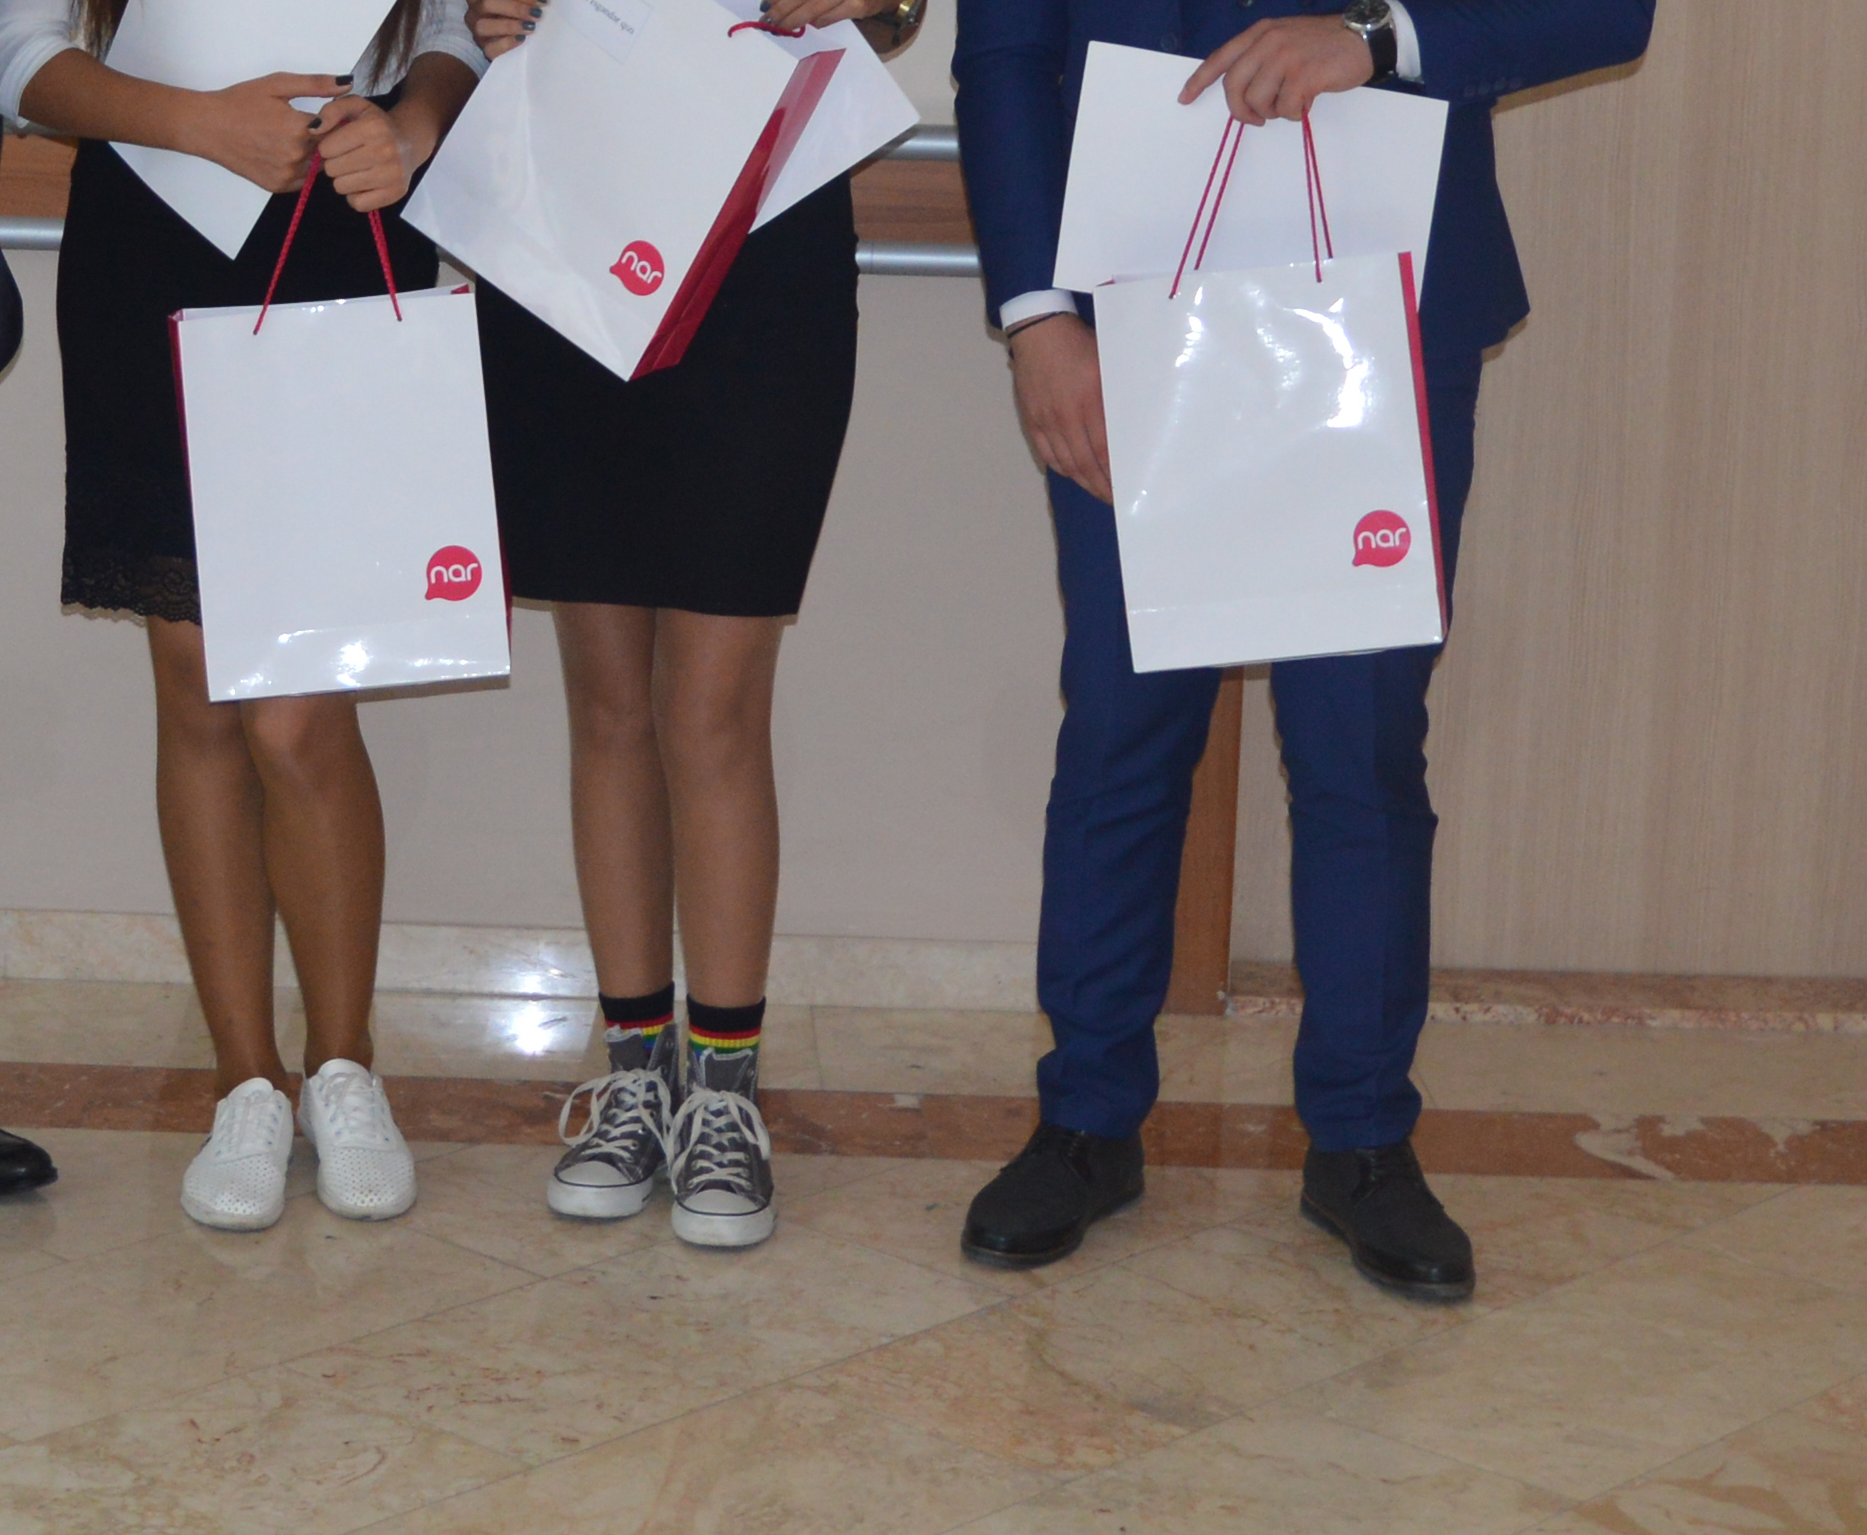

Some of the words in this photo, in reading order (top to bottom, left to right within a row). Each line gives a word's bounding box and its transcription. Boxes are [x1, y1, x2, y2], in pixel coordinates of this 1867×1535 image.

[621, 251, 663, 284] nar
[1357, 527, 1407, 550] nar
[430, 563, 479, 584] nar
